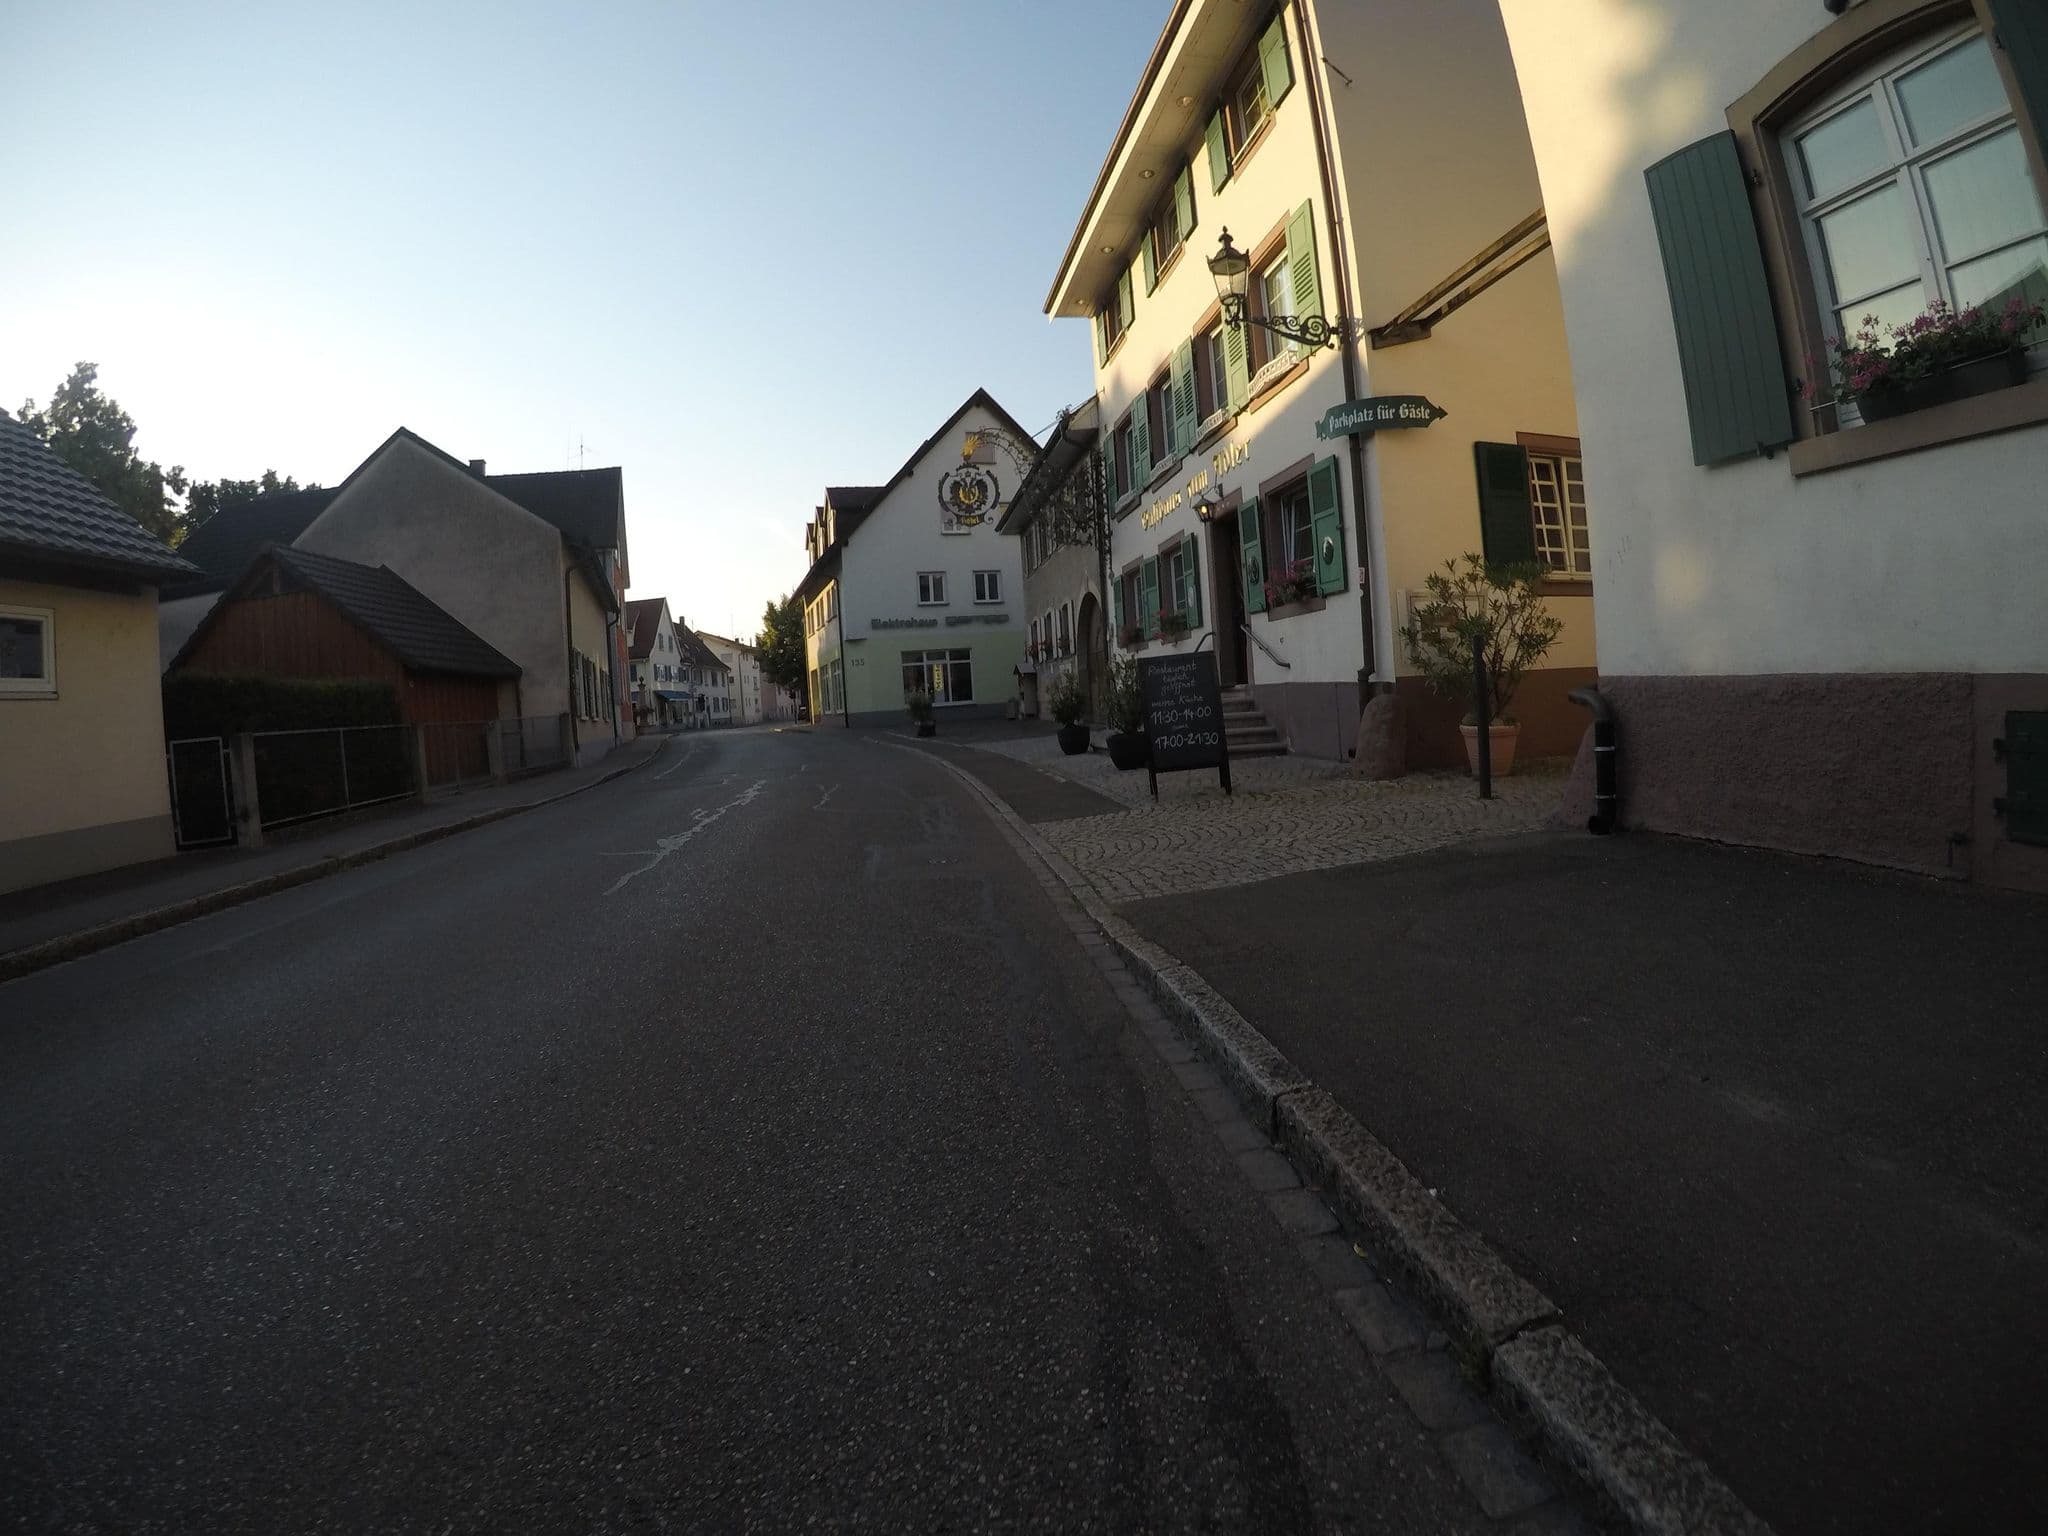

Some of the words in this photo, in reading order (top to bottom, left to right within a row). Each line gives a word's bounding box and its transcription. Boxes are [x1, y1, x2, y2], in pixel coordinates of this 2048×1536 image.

[1329, 407, 1374, 433] Parkplatz
[1377, 404, 1396, 420] für
[1400, 403, 1431, 420] Gäste
